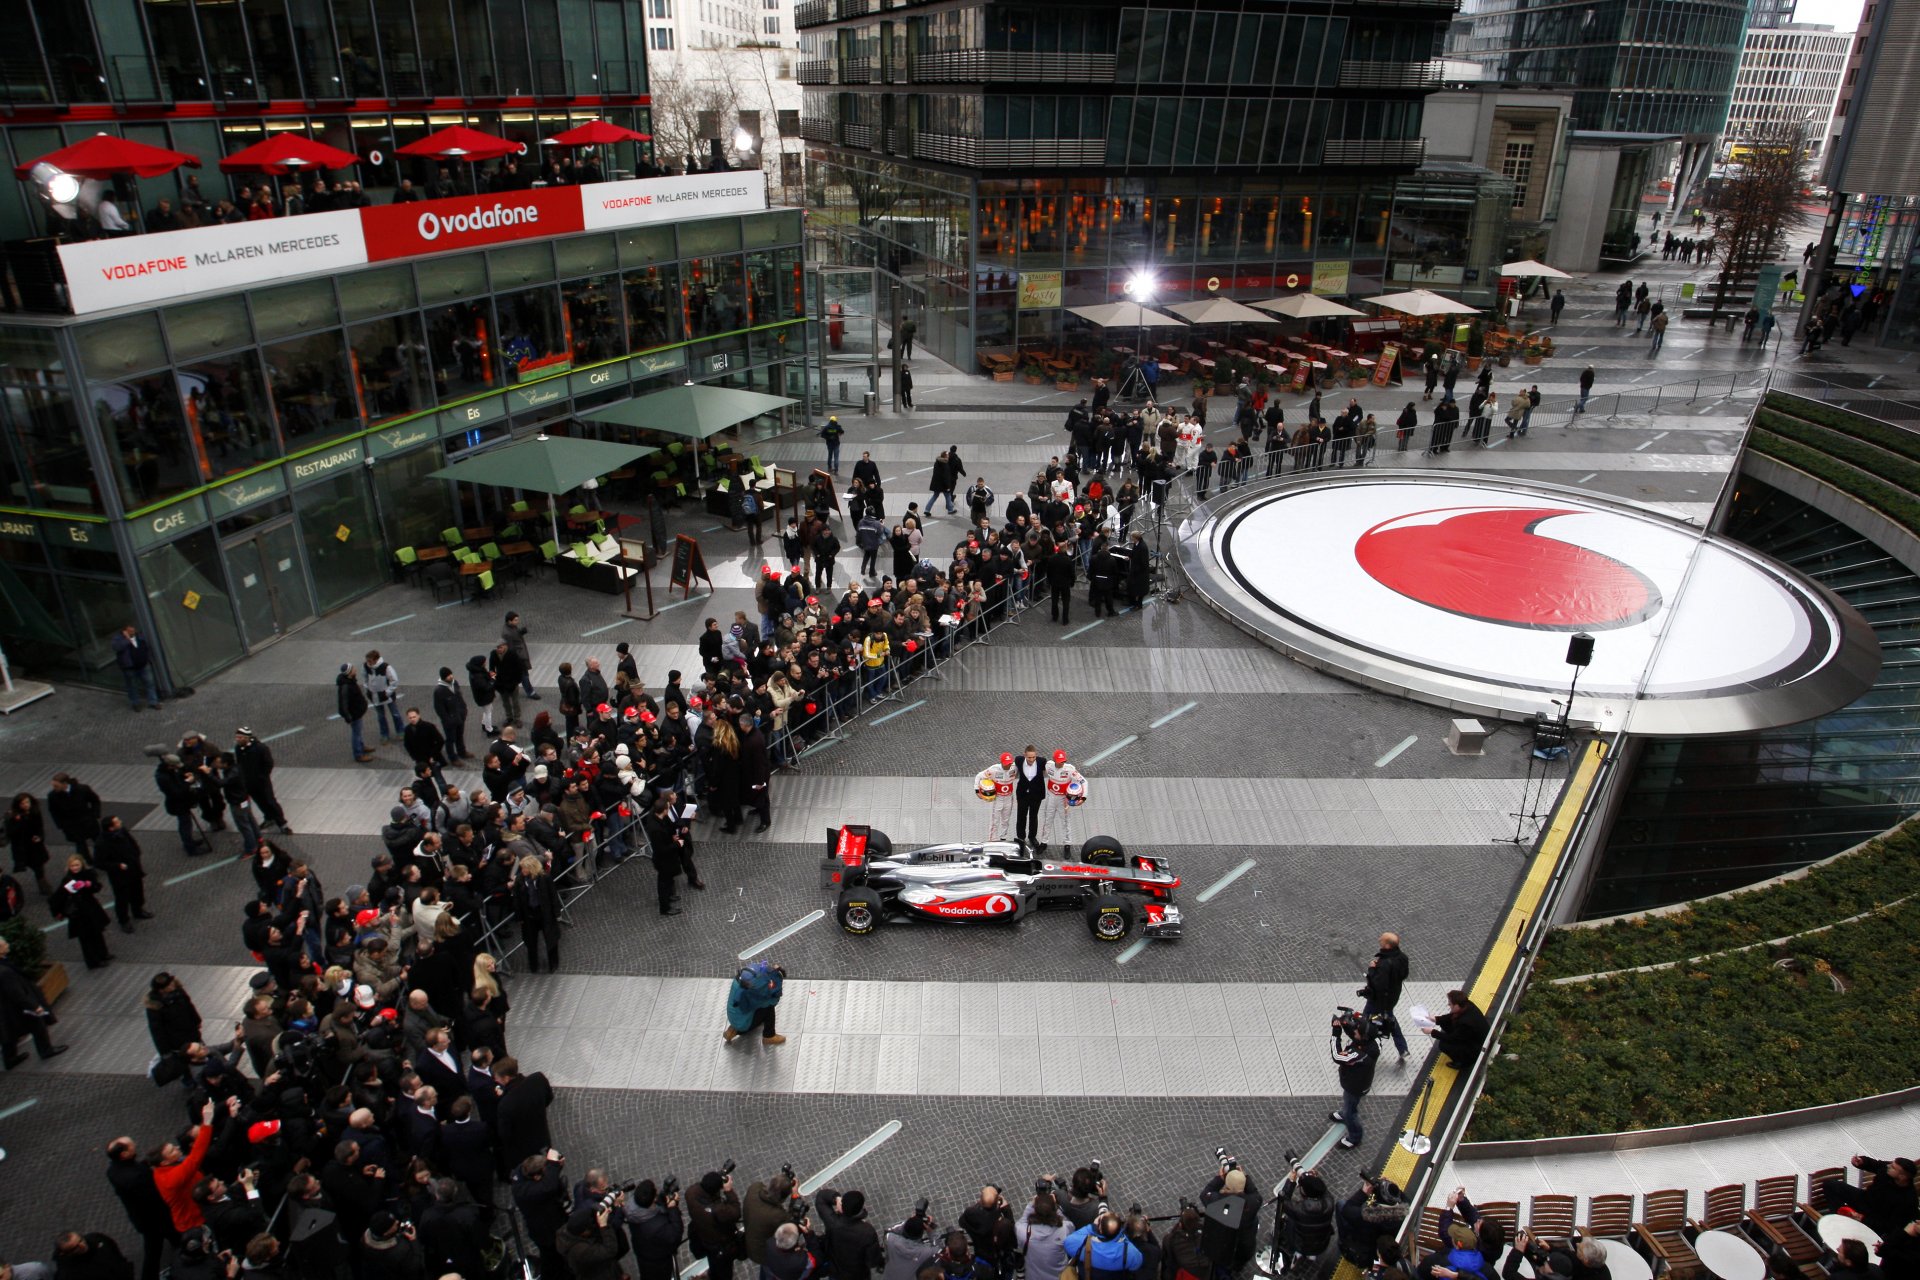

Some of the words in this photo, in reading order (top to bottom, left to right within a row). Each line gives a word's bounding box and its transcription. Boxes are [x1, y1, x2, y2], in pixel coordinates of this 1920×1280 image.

[602, 195, 652, 209] VODAFONE
[656, 191, 699, 204] McLAREN
[701, 187, 748, 199] MERCEDES
[440, 203, 538, 233] vodafone
[102, 256, 187, 280] VODAFONE
[194, 244, 264, 266] McLAREN
[268, 234, 340, 255] MERCEDES
[295, 448, 358, 478] RESTAURANT
[918, 853, 944, 862] Mobil
[939, 906, 985, 915] vodafone
